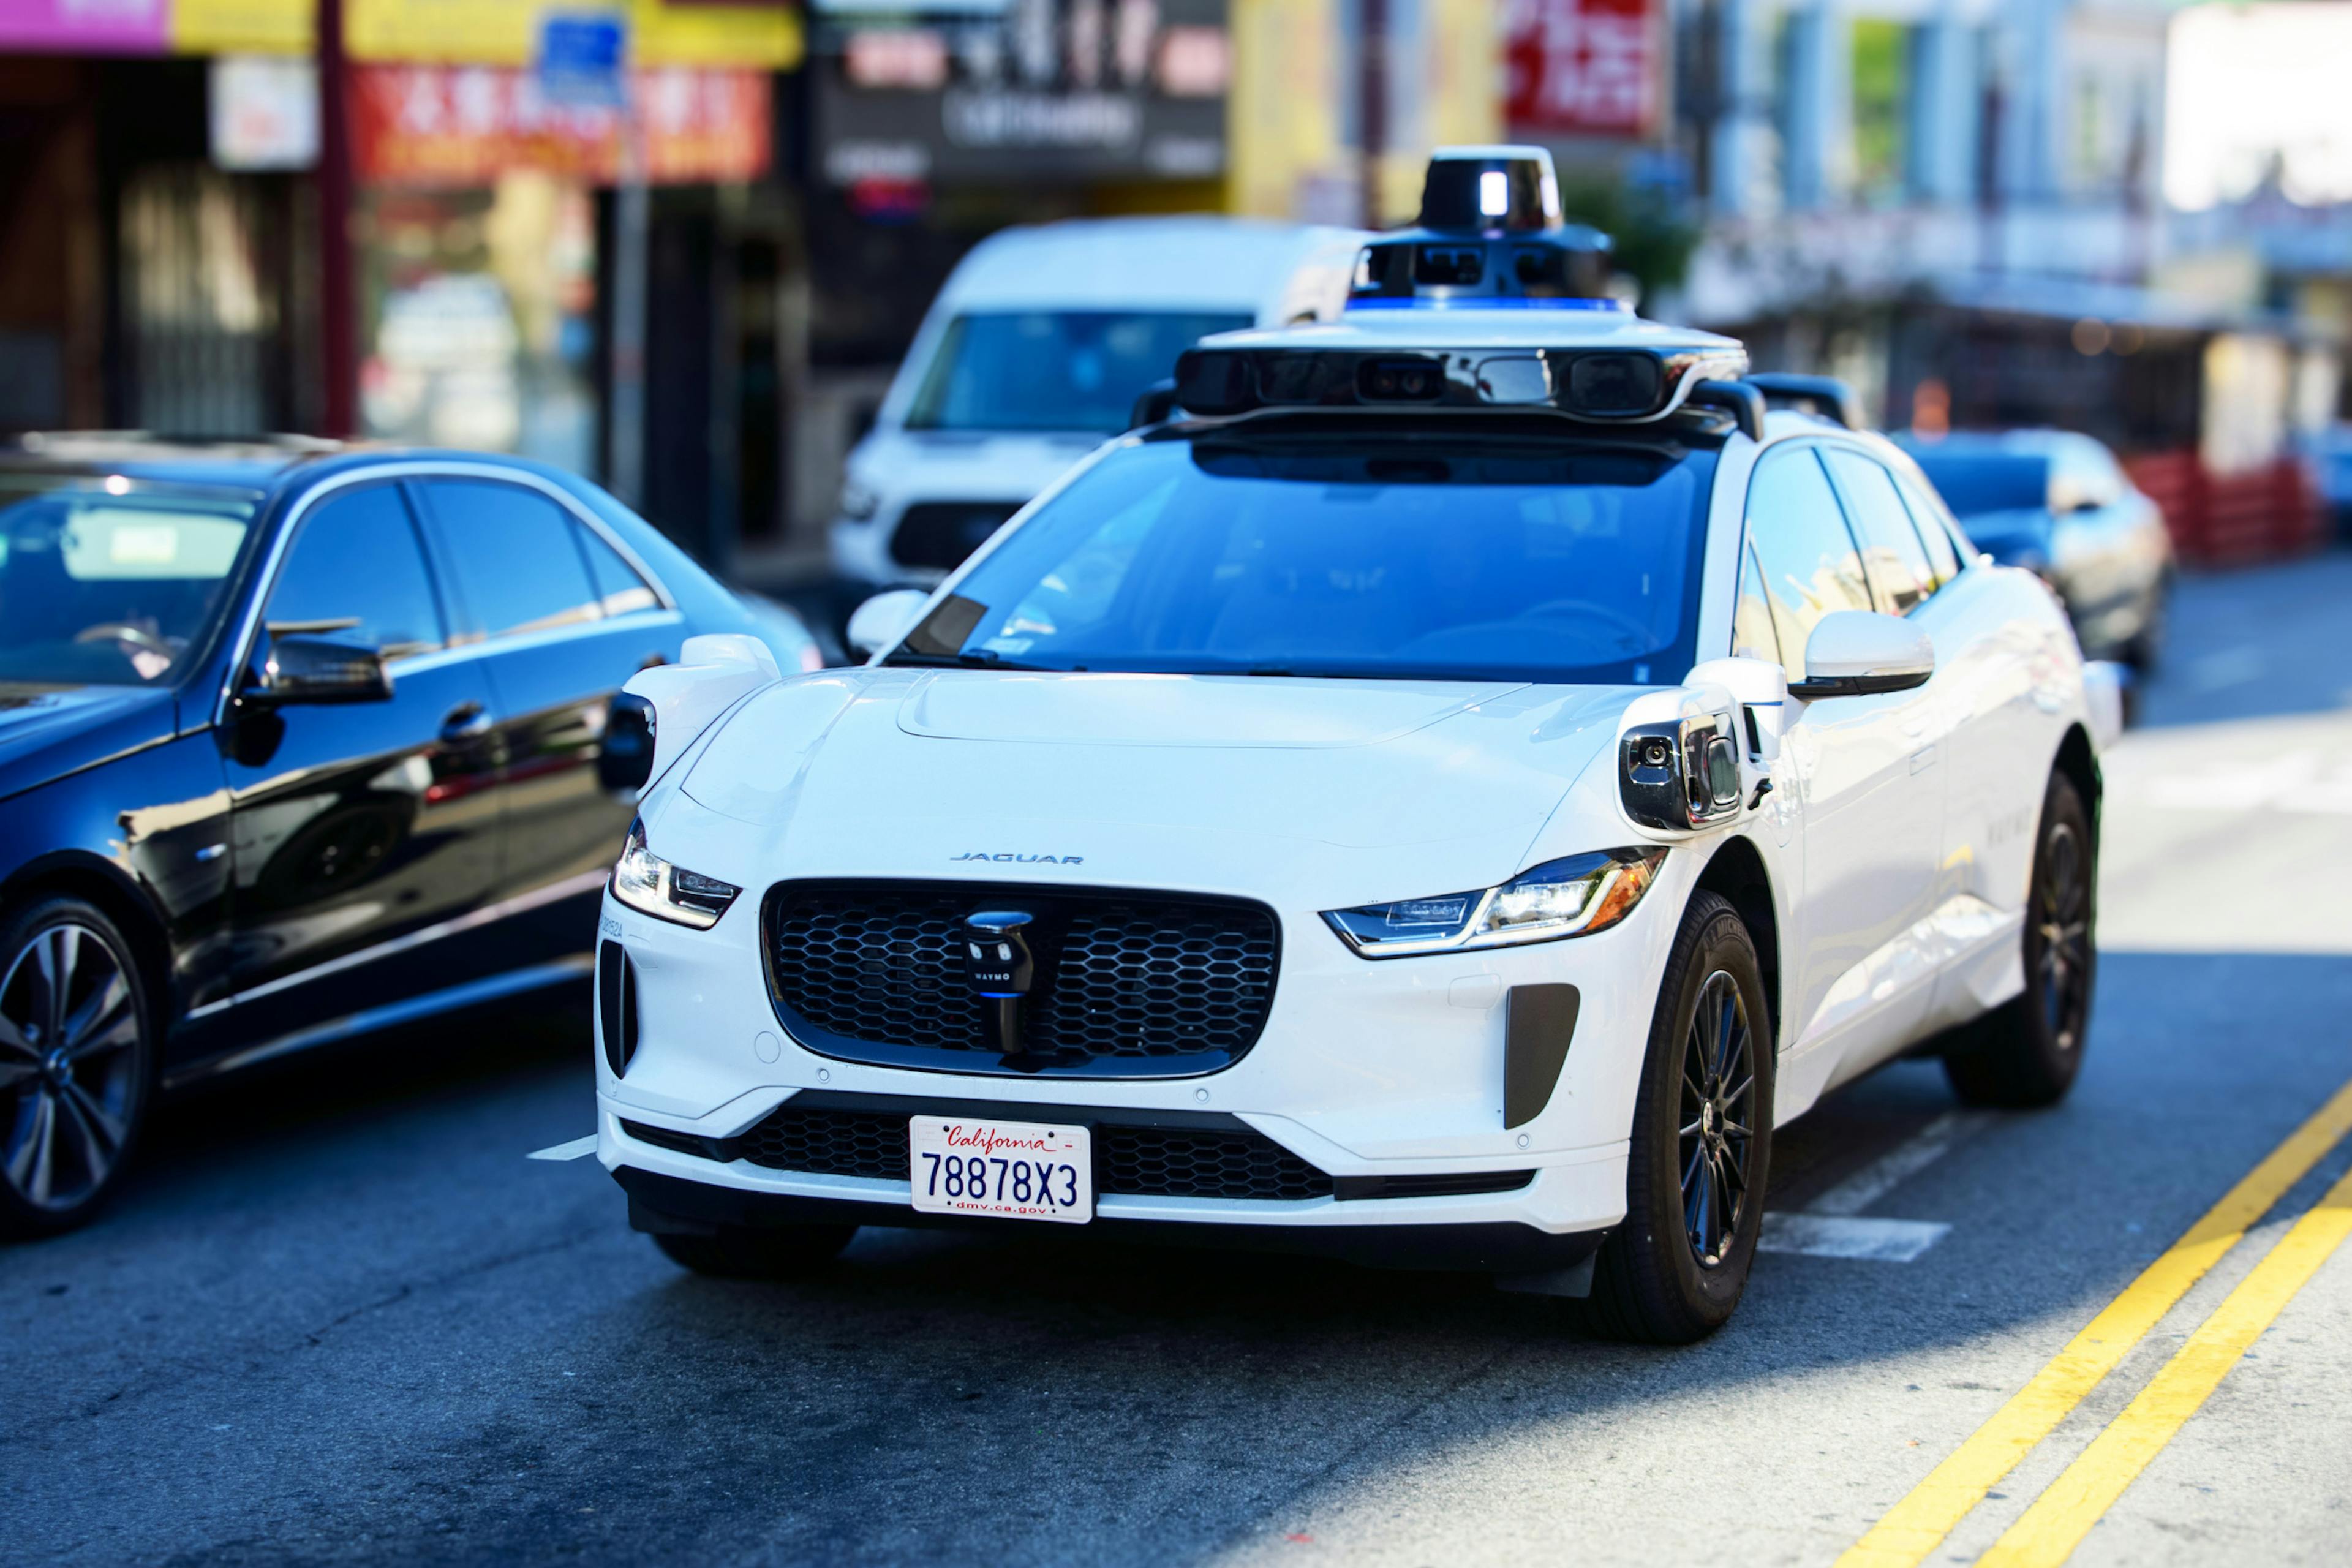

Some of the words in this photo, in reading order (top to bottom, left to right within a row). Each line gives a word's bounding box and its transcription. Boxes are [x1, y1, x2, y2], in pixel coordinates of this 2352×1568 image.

[949, 853, 1084, 865] JAGUAR
[948, 1125, 1057, 1155] California
[922, 1152, 1077, 1207] 78878X3
[957, 1201, 1046, 1214] dmv.ca.gov
